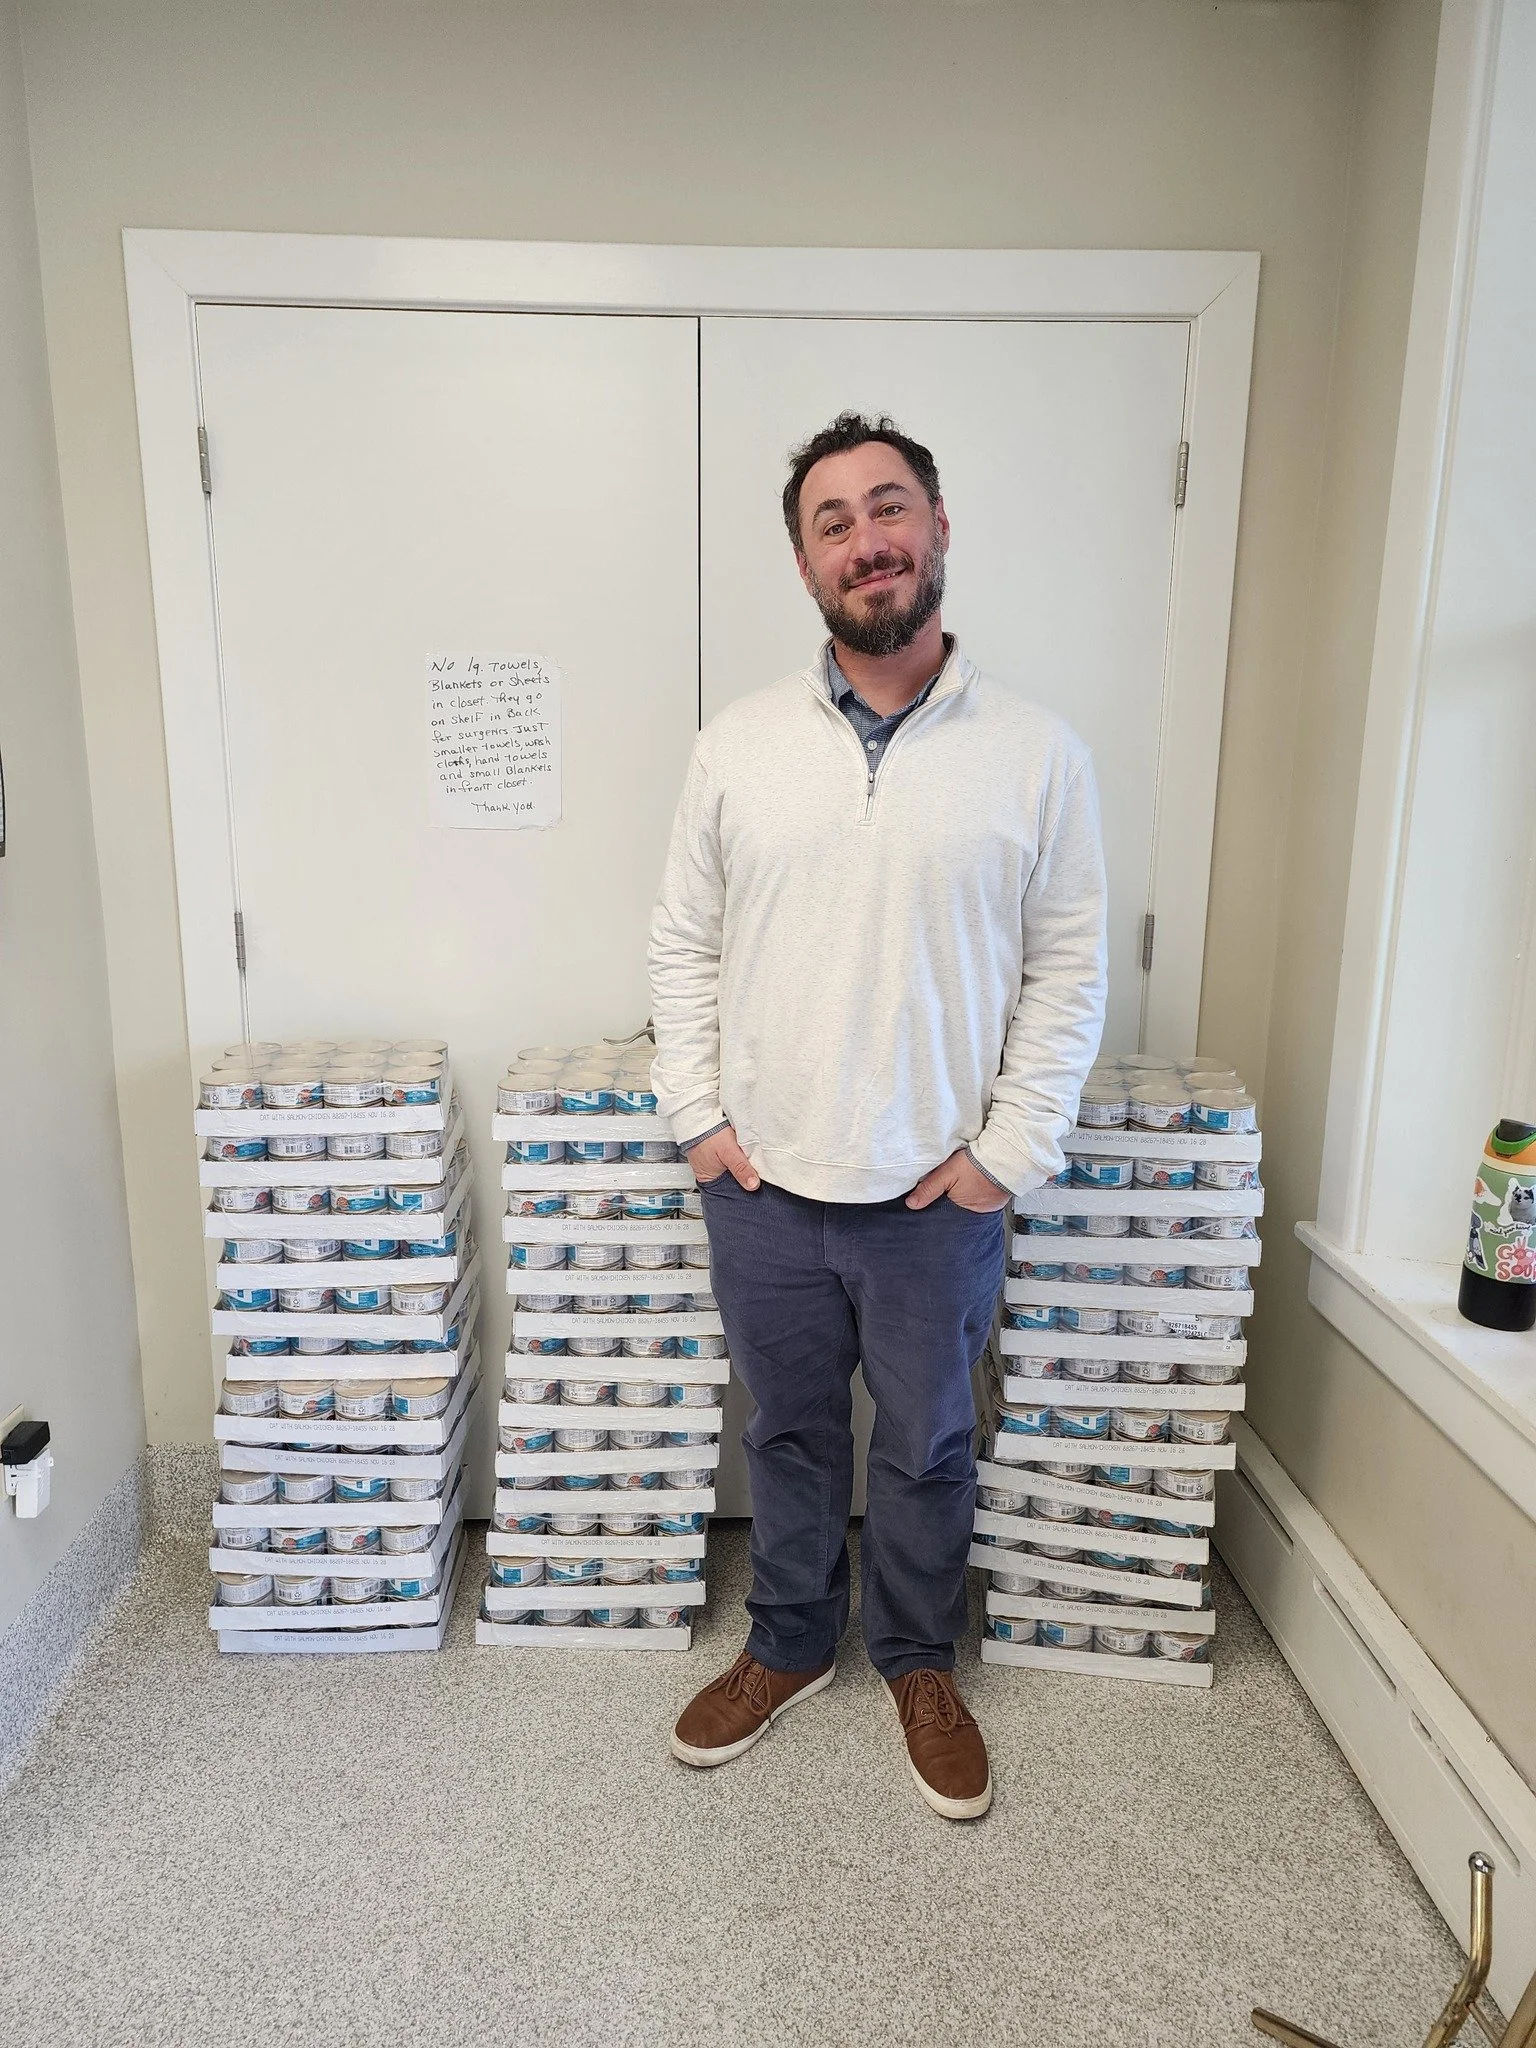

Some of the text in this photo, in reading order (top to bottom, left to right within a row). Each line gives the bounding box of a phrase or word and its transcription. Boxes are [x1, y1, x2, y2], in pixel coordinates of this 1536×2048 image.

[431, 657, 454, 672] No
[428, 679, 482, 691] Blankets
[432, 700, 443, 709] in
[526, 693, 542, 703] go
[490, 713, 500, 721] in
[433, 745, 478, 758] smaller
[475, 753, 500, 765] hand
[504, 750, 548, 763] towels
[440, 769, 462, 781] and
[470, 768, 500, 778] small
[446, 785, 456, 793] in
[471, 801, 510, 813] Thank
